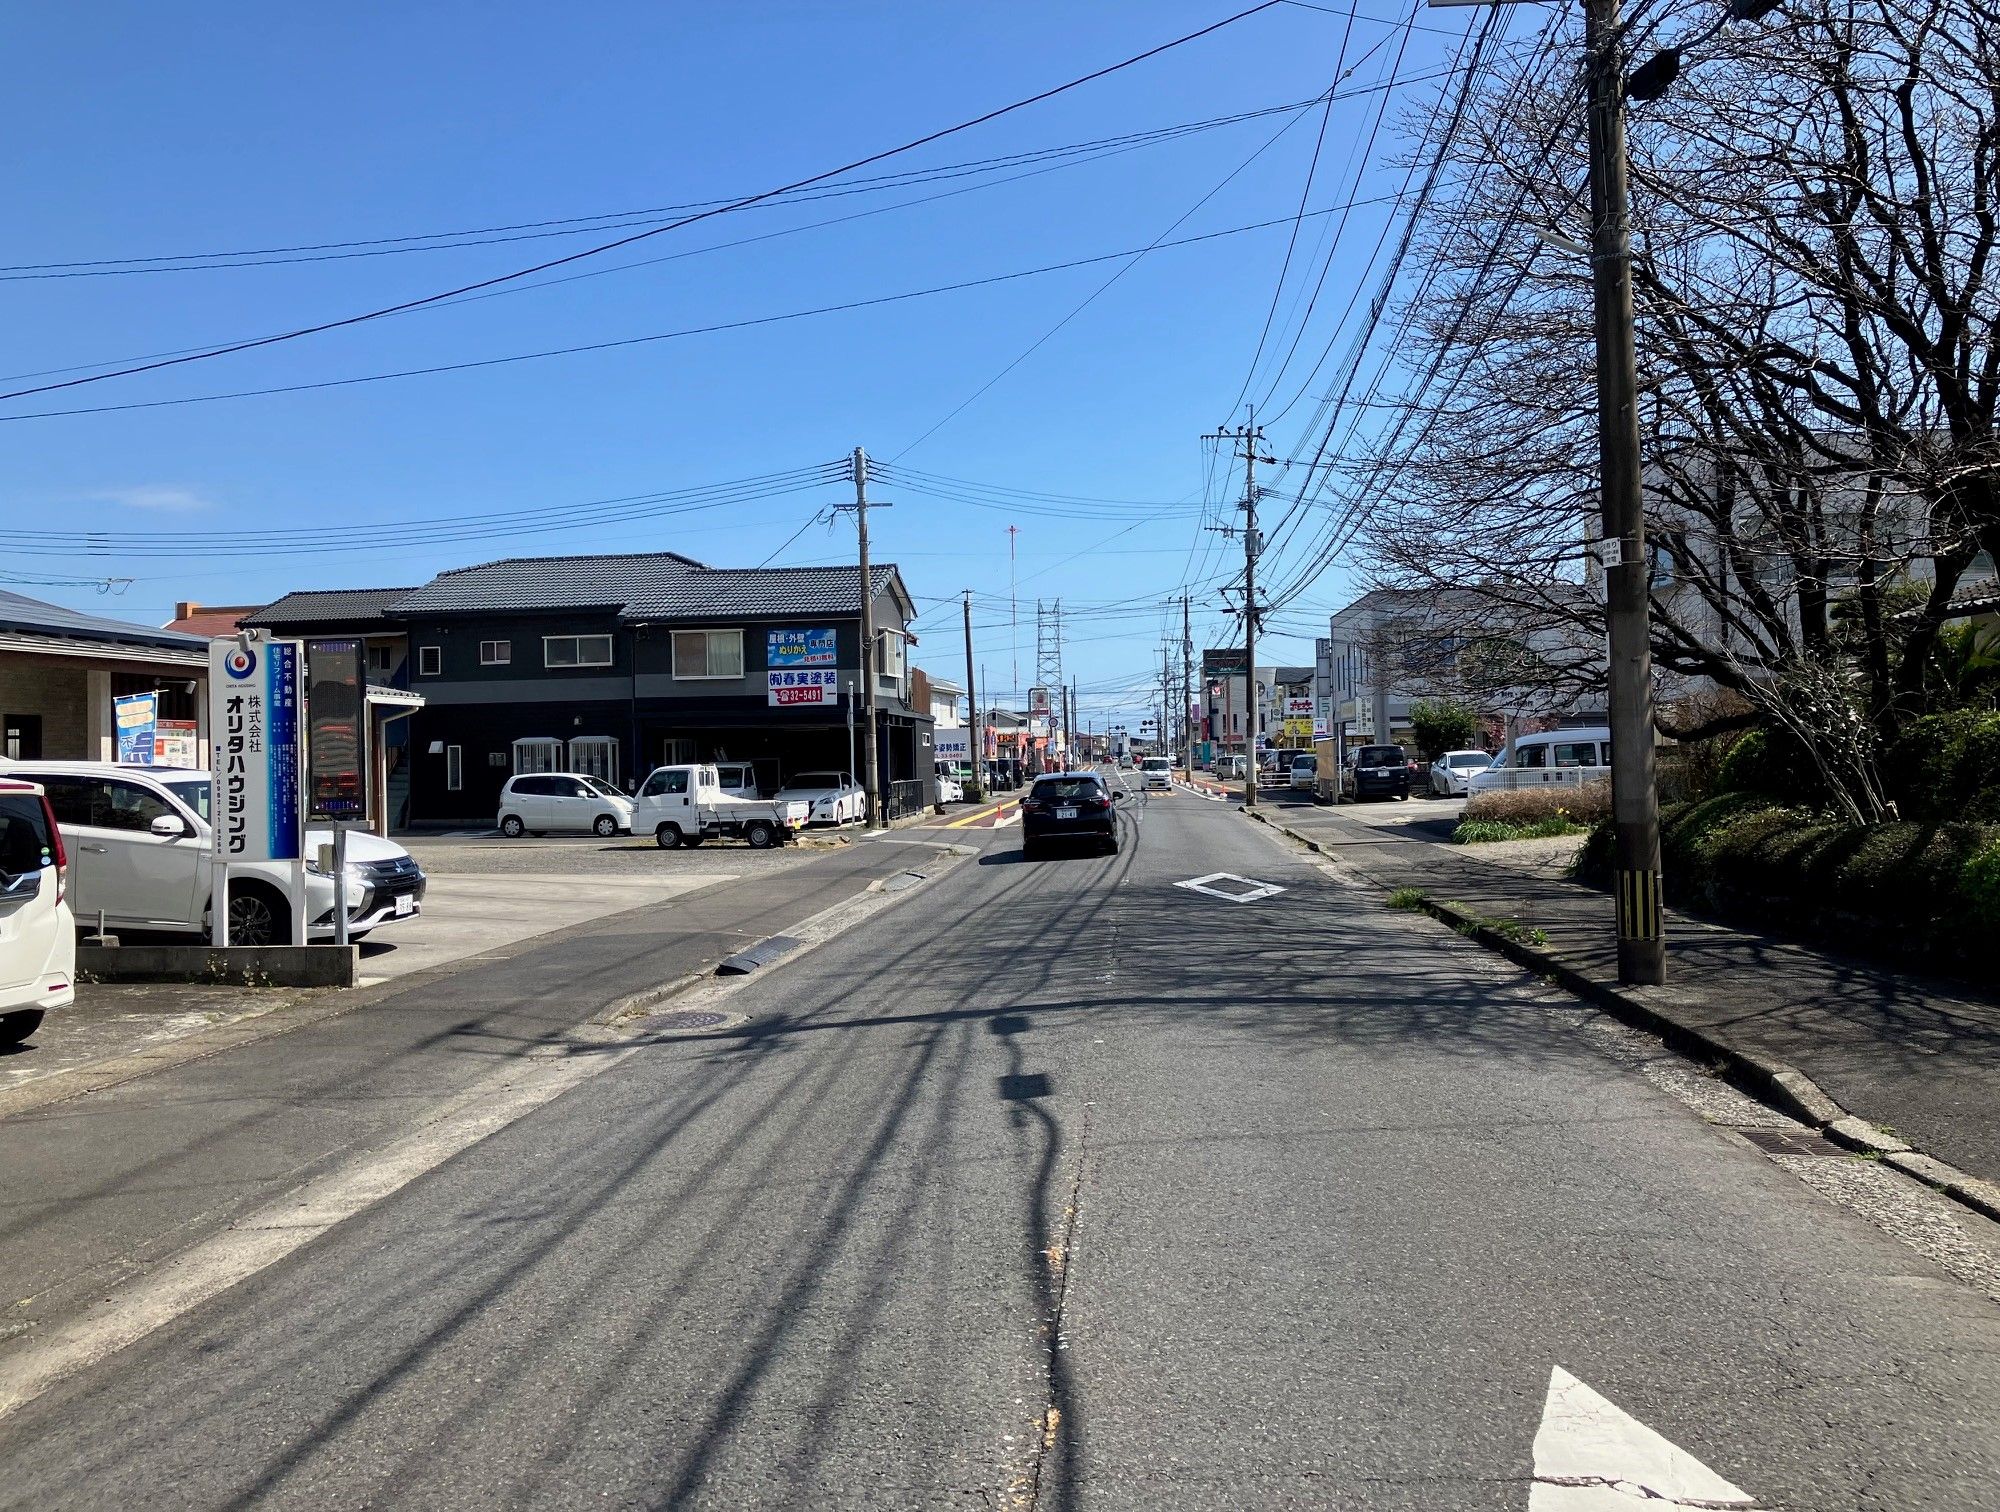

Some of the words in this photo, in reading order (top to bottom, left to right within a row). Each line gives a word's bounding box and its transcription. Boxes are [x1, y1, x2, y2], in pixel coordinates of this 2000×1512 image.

[809, 639, 835, 649] 専門店
[779, 645, 808, 655] ぬりかえ
[804, 653, 833, 663] 見積り無料
[283, 647, 293, 708] 総合不動産
[790, 690, 821, 701] 32-5491
[248, 695, 261, 753] 株式会社
[226, 695, 246, 854] オリタハウジング
